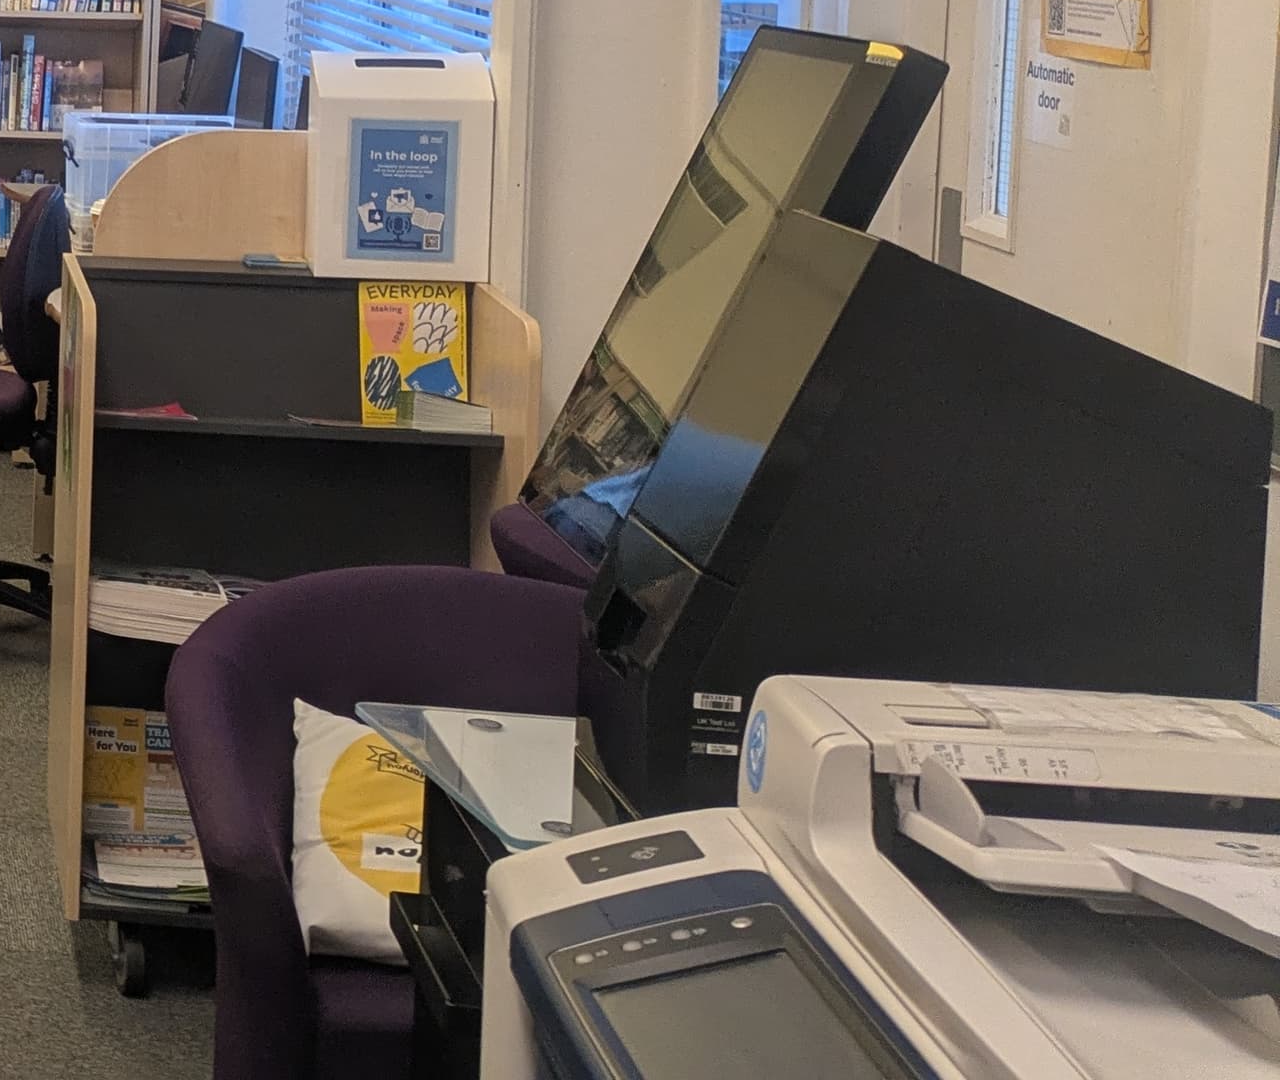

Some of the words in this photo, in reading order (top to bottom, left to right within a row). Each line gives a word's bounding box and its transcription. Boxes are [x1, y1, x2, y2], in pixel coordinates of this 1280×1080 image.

[1027, 60, 1075, 87] Automatic
[1038, 90, 1060, 111] door
[370, 150, 382, 160] In
[385, 151, 407, 161] the
[410, 151, 438, 164] loop
[367, 285, 457, 299] EVERYDAY
[371, 305, 402, 314] Making
[392, 322, 405, 344] space
[88, 728, 115, 738] Here
[147, 727, 170, 738] TRA
[96, 742, 114, 751] for
[115, 742, 137, 753] You
